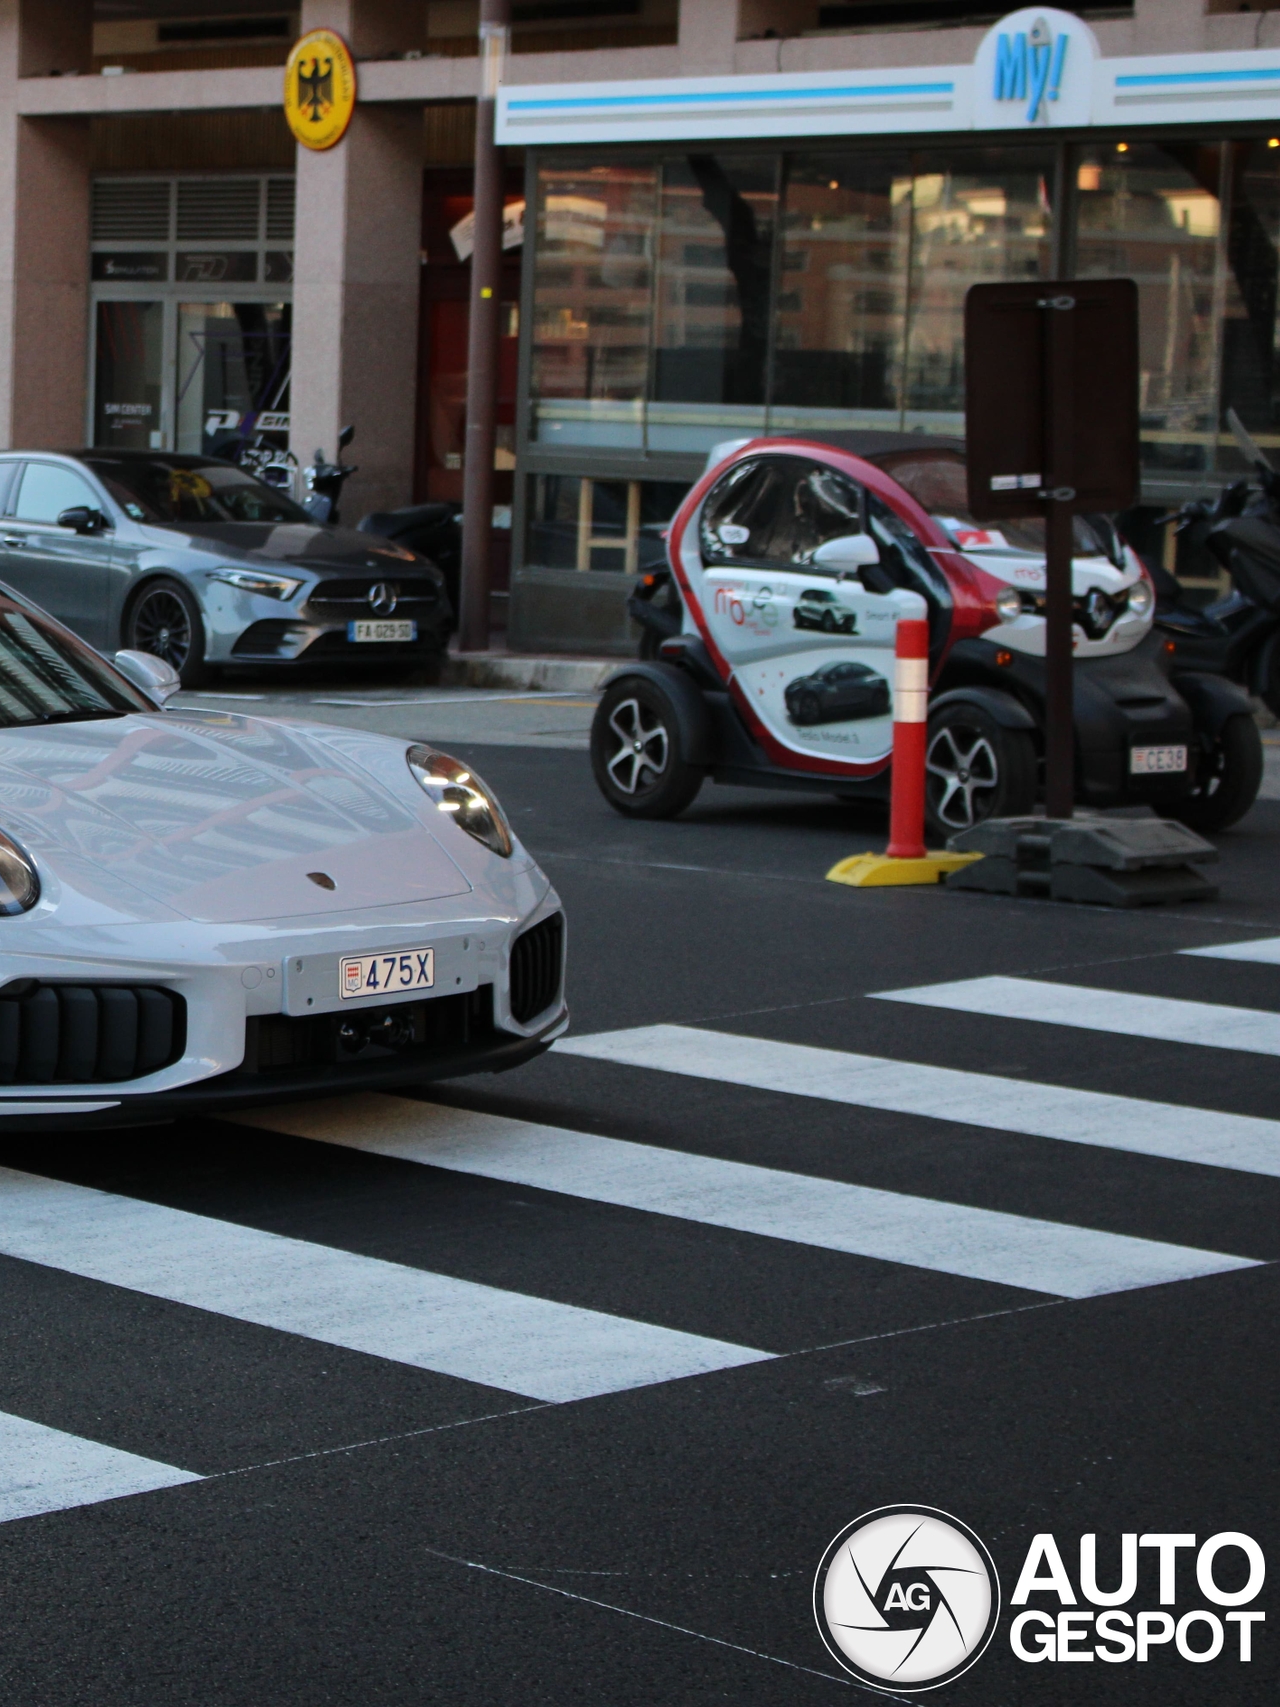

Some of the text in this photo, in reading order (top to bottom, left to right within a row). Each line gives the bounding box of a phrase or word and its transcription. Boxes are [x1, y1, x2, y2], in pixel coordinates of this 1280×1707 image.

[993, 32, 1069, 122] My!
[347, 978, 359, 988] MC
[366, 953, 429, 990] 475X
